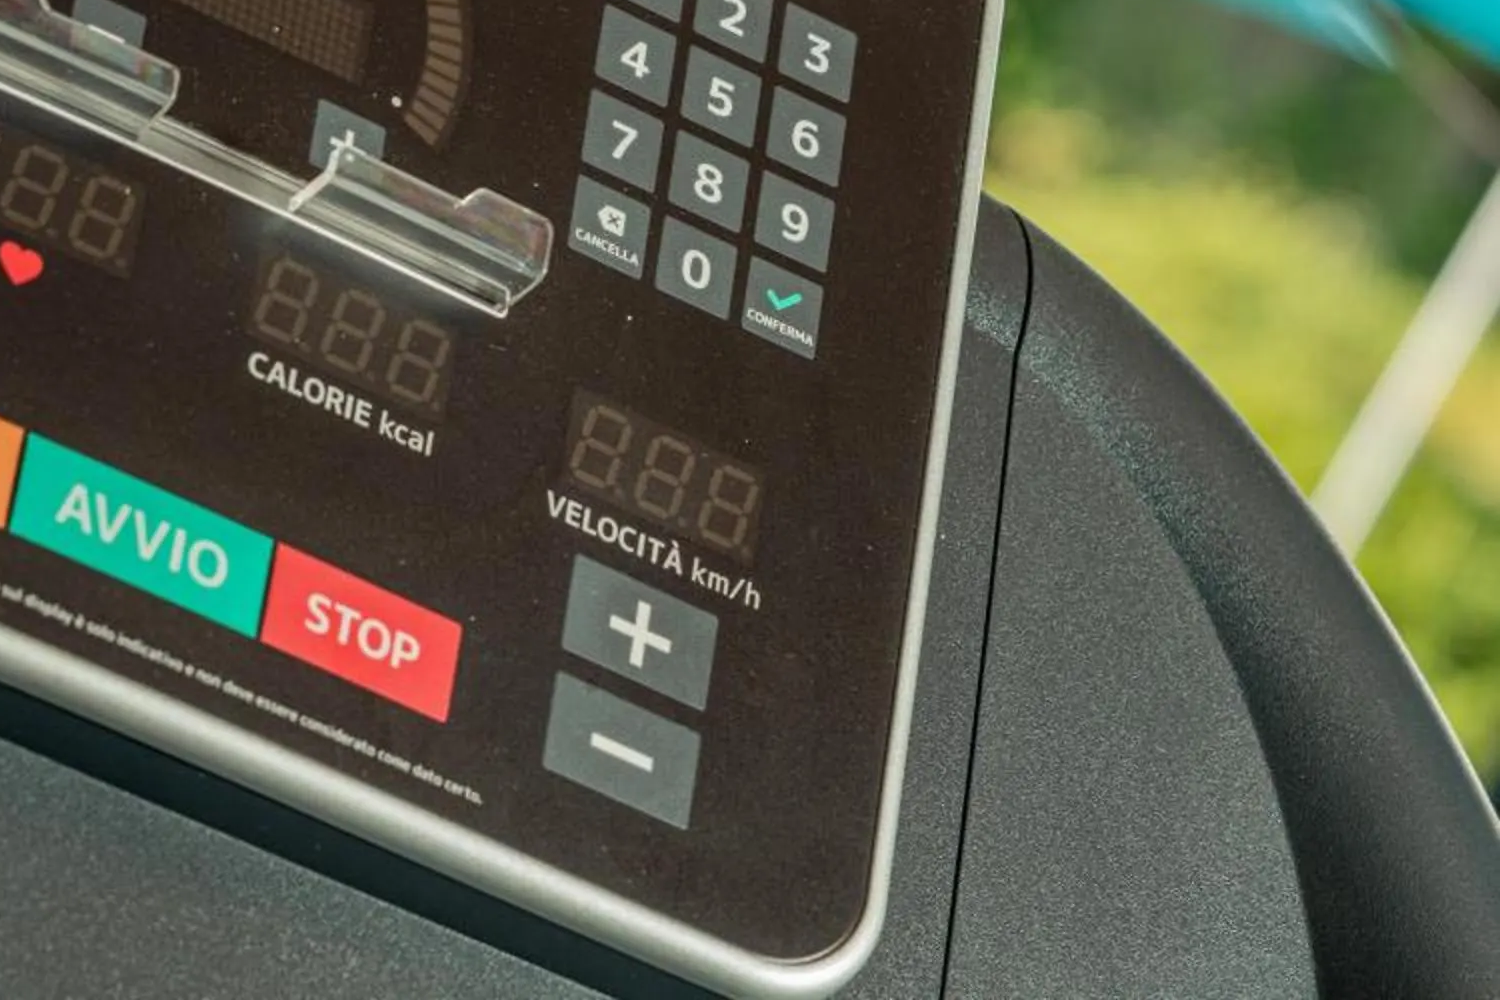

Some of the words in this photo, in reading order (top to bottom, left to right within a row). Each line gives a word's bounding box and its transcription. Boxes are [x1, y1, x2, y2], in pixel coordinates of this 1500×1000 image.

[621, 41, 649, 78] 4
[804, 33, 831, 74] 3
[707, 76, 735, 117] 5
[612, 120, 638, 159] 7
[791, 119, 820, 159] 6
[694, 162, 723, 204] 8
[781, 203, 809, 243] 9
[574, 227, 639, 267] CANCELLA
[681, 249, 711, 289] 0
[747, 309, 813, 346] CONFERMA
[248, 351, 373, 428] CALORIE
[379, 409, 434, 457] kcal
[54, 483, 228, 588] AVVIO
[547, 490, 683, 576] VELOCITÀ
[691, 557, 761, 610] km/h
[304, 593, 420, 670] STOP
